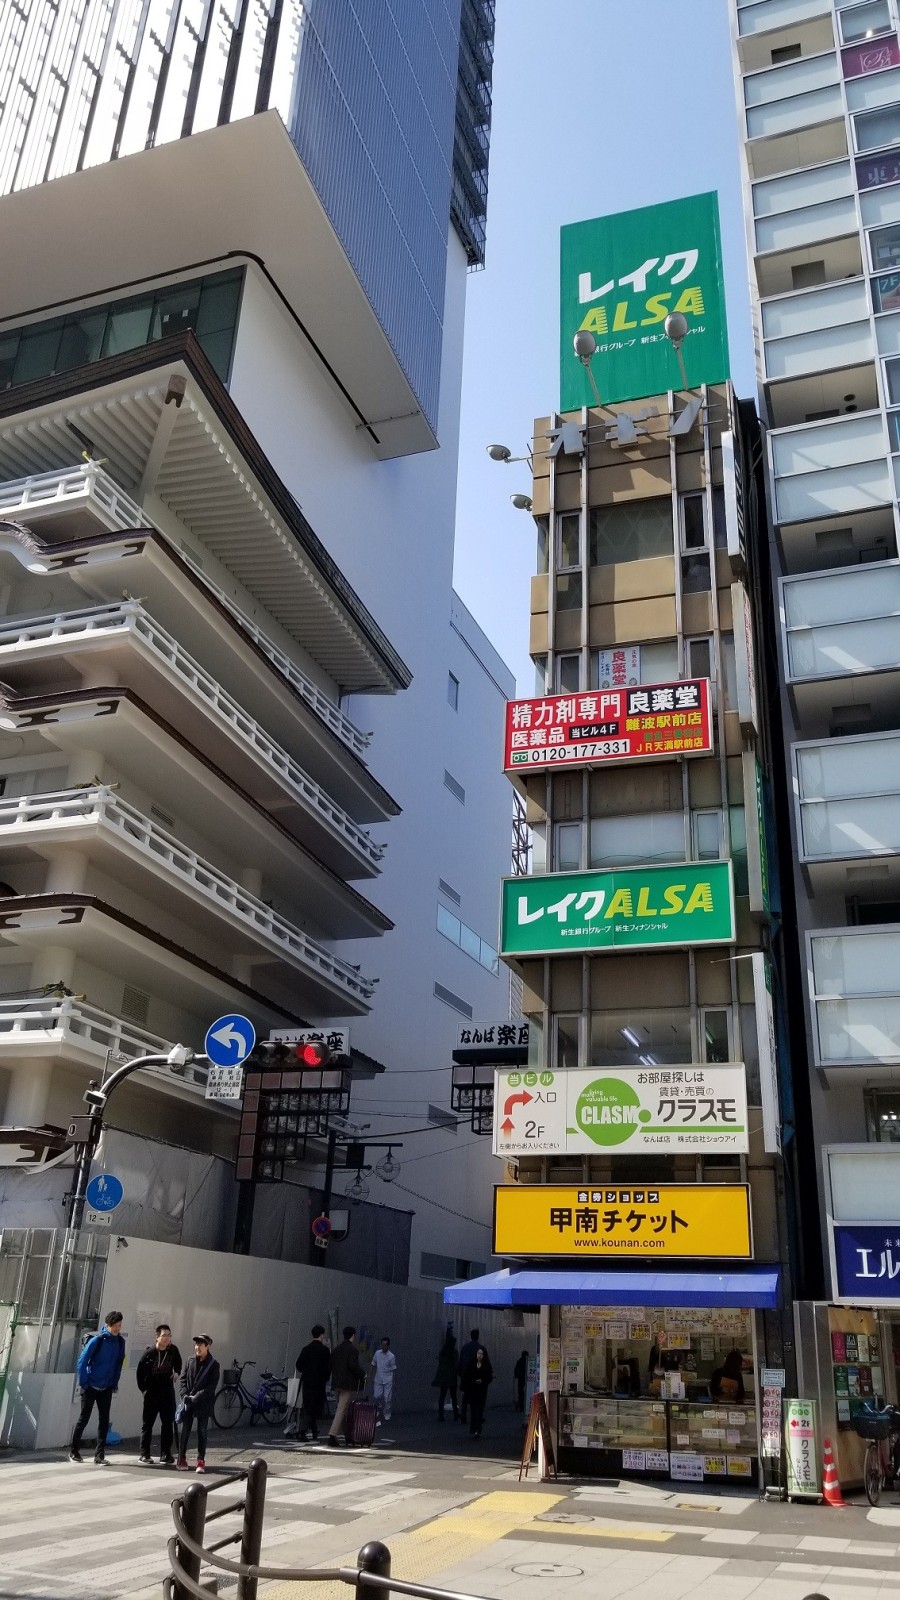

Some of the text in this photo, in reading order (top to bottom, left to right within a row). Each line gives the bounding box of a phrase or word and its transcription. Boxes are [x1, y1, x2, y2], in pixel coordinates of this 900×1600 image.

[578, 248, 699, 304] レイク
[577, 286, 705, 335] ALSA
[511, 685, 699, 729] 精力剤専門 良薬堂
[624, 711, 702, 732] 難波駅前店
[511, 726, 565, 748] 医薬品
[531, 741, 628, 762] 0120-177-331
[560, 922, 669, 937] 新生銀行グループ 新生フィナンシャル
[637, 1071, 705, 1084] お部屋探しは
[534, 1091, 557, 1104] 入口
[658, 1086, 715, 1097] 賃貸・売買の
[657, 1098, 737, 1123] クラスモ
[524, 1120, 546, 1139] 2F
[643, 1135, 737, 1143] なんば店 株式会社ショウアイ
[550, 1206, 689, 1234] 甲南チケット
[574, 1238, 666, 1248] www.kounan.com
[801, 1439, 811, 1481] クラスモ
